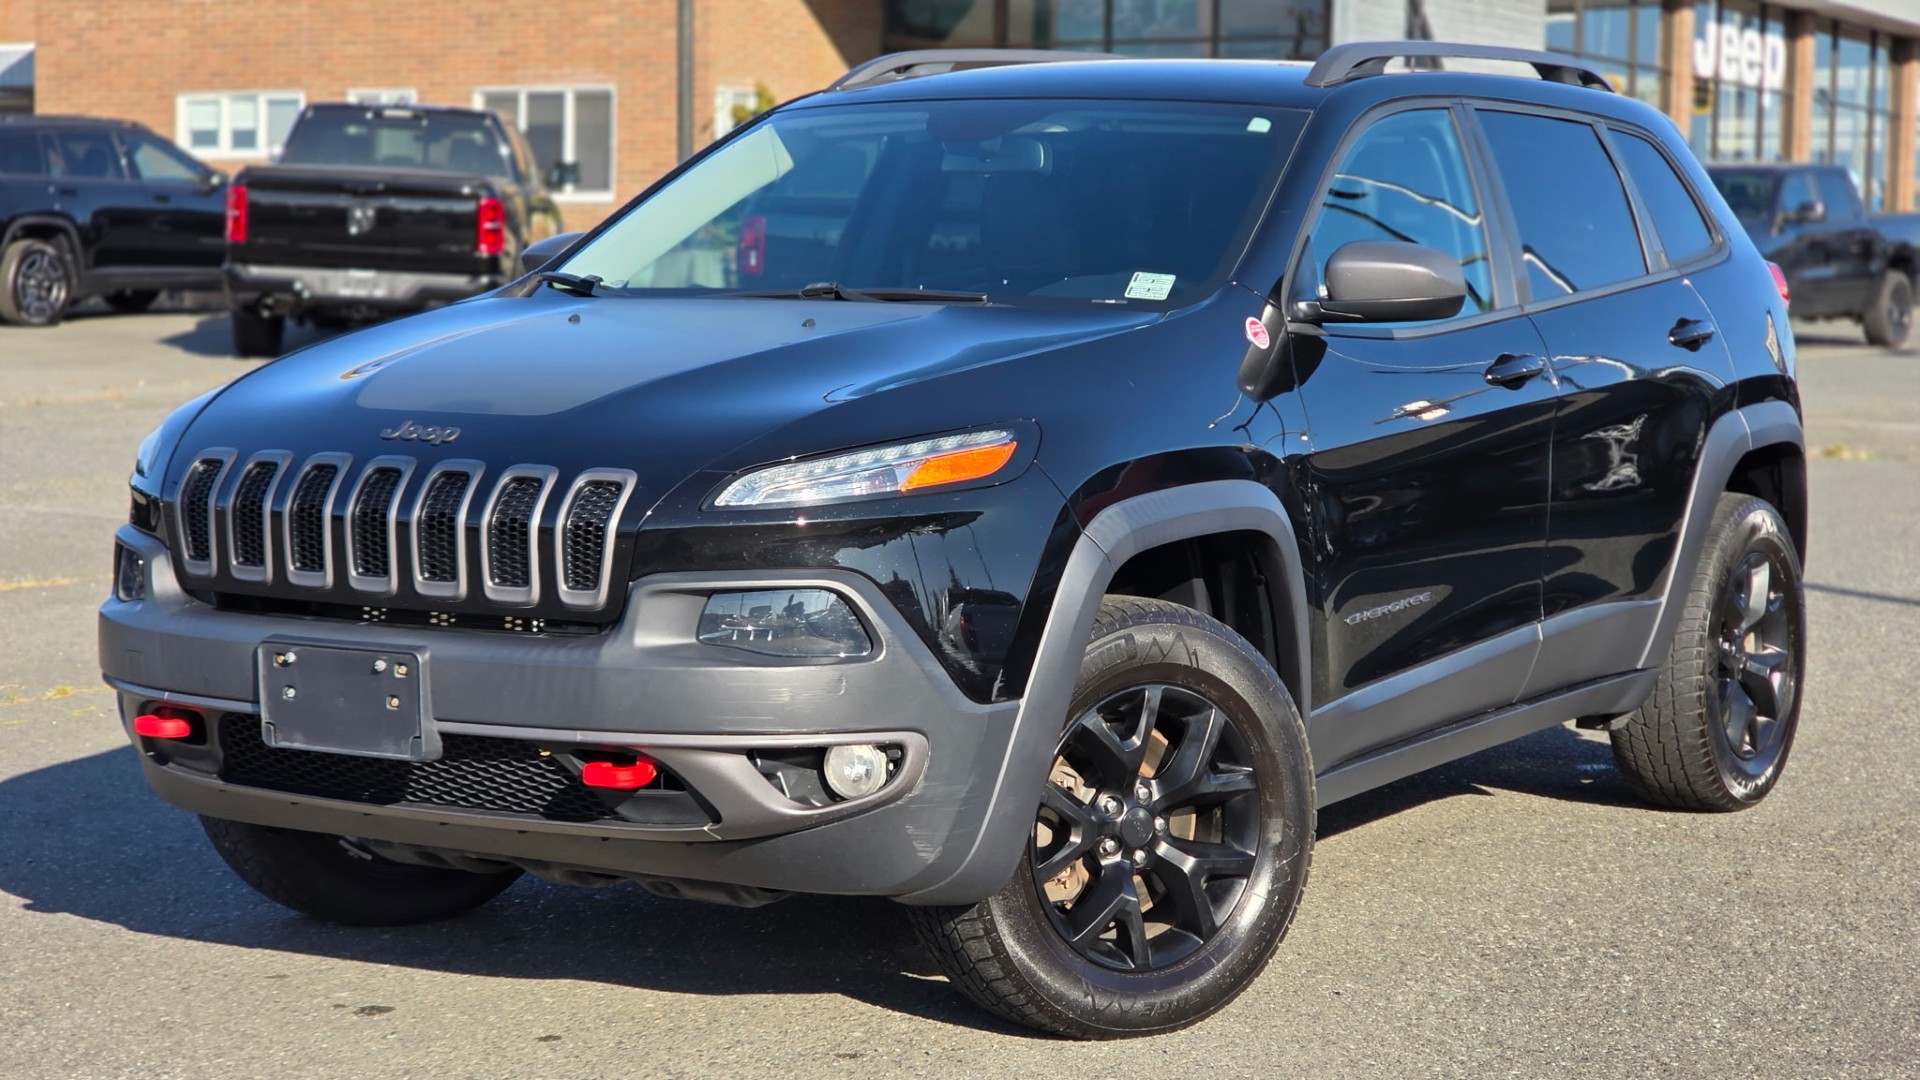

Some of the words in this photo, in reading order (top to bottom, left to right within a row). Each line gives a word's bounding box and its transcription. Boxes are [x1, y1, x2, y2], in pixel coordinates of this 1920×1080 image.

[1693, 20, 1786, 107] Jeep
[379, 420, 461, 446] Jeep
[1344, 591, 1431, 625] CHEROKEE
